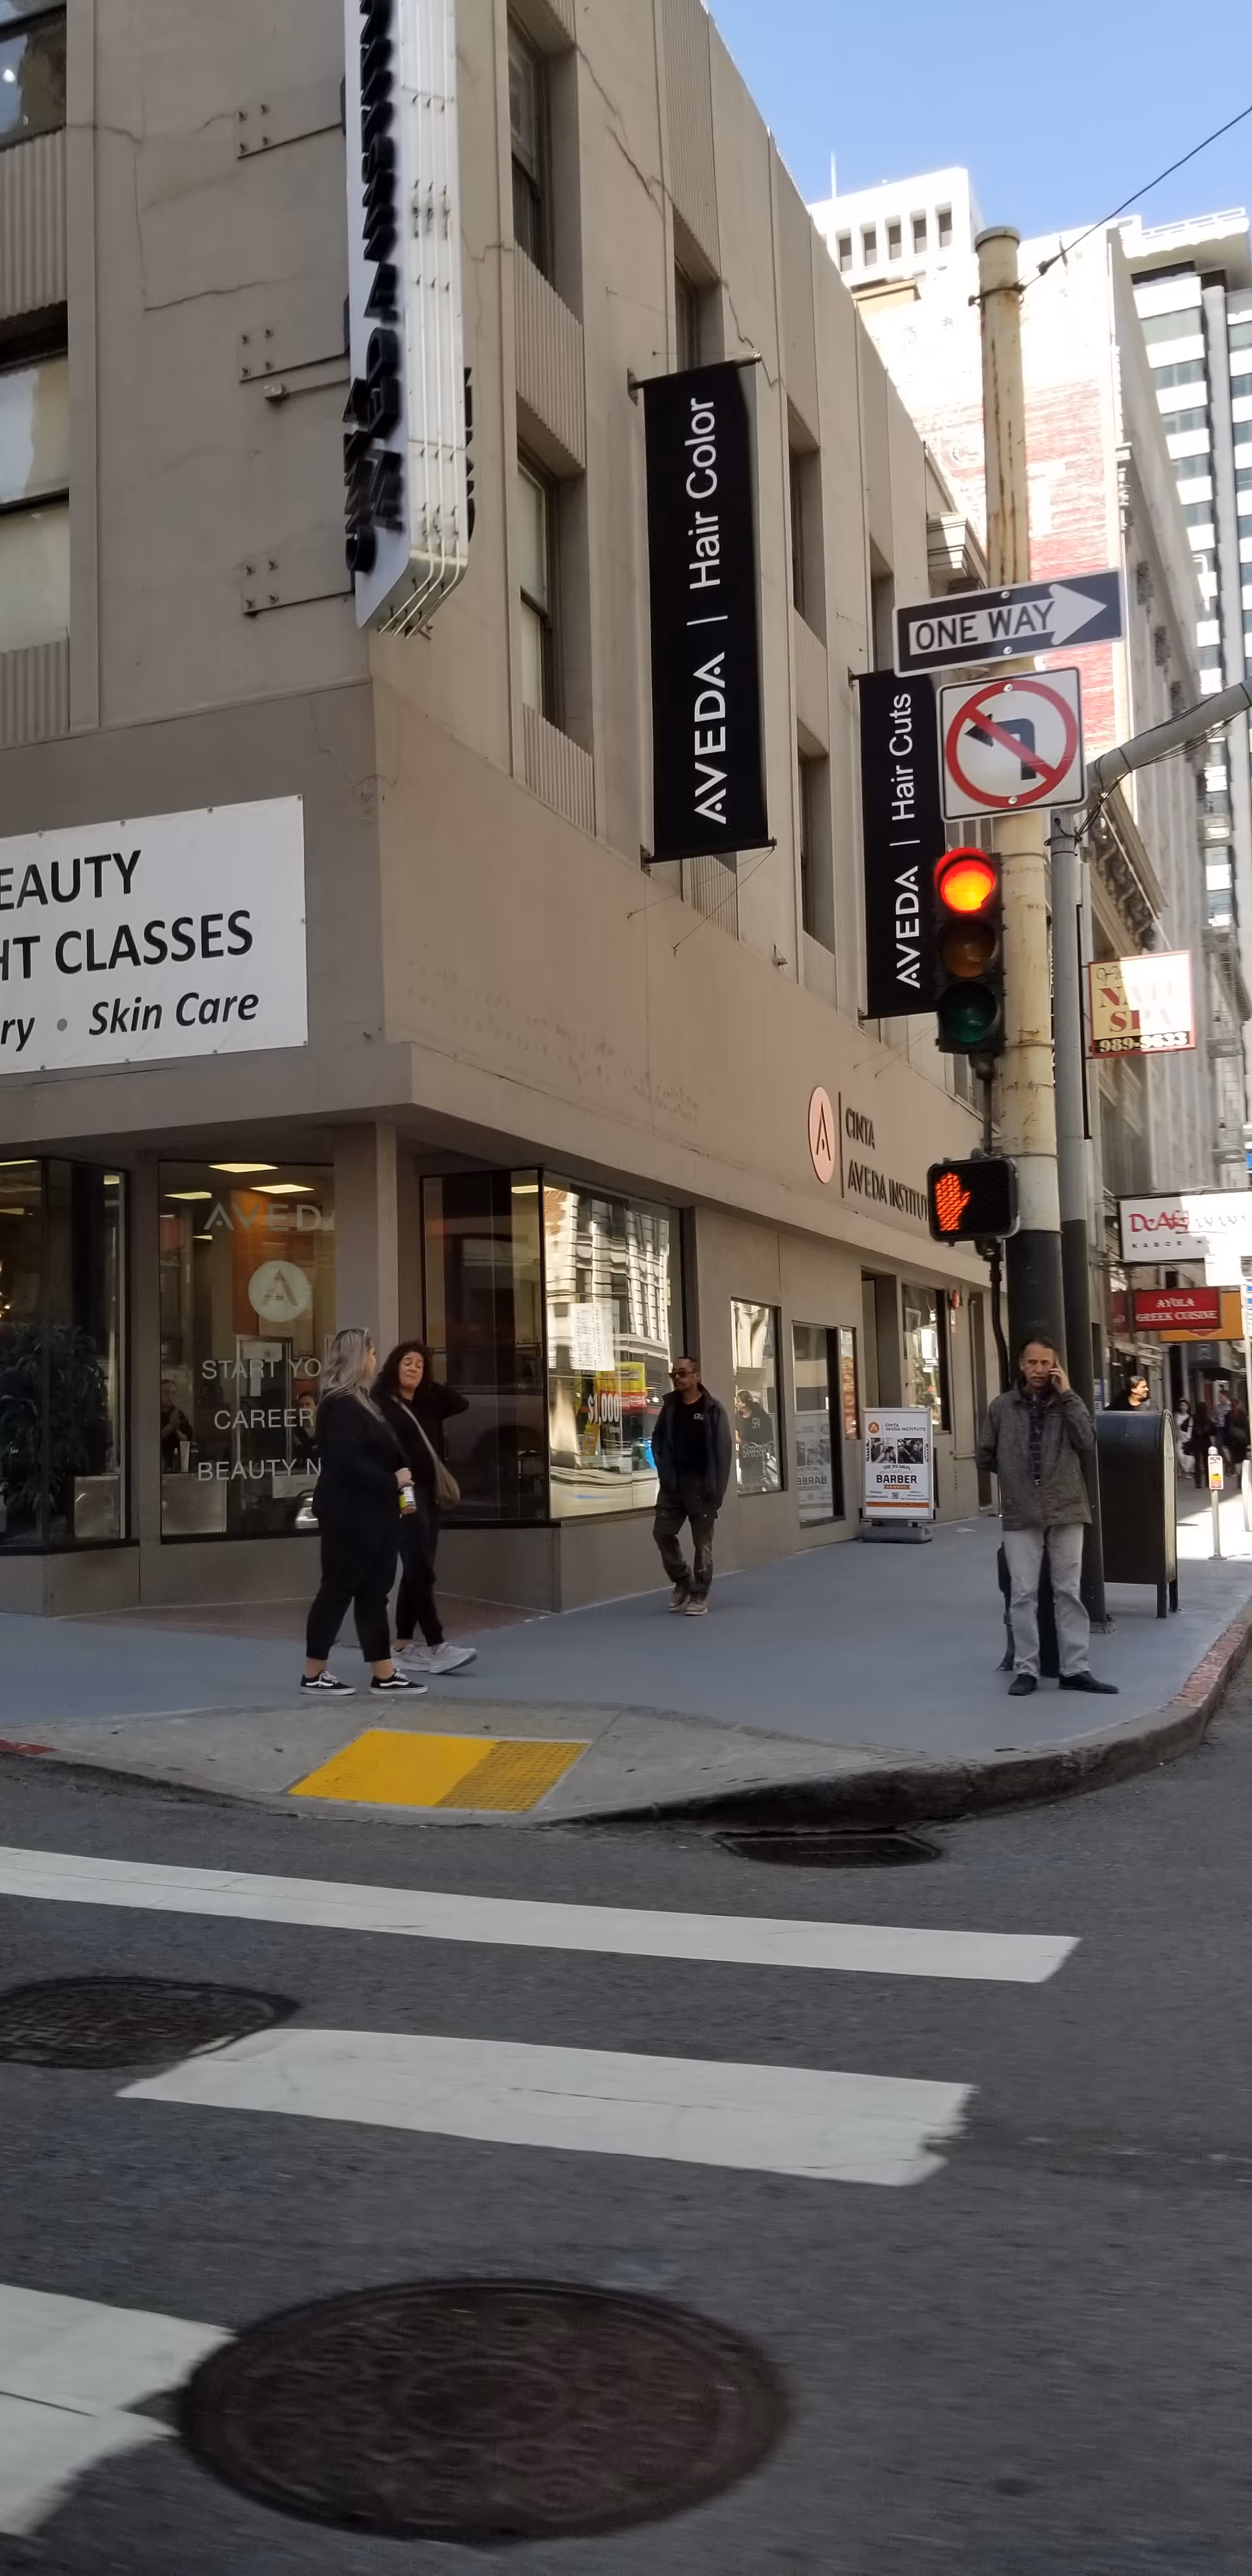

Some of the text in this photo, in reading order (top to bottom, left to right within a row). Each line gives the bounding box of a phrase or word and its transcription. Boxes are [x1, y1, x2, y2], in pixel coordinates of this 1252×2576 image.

[685, 397, 728, 825] AVEDA Hair Color
[916, 602, 1055, 650] ONE WAY
[889, 693, 920, 989] AVEDA Hair Cuts
[55, 910, 253, 974] CLASSES
[89, 996, 162, 1036] Skin
[175, 992, 260, 1027] Care
[846, 1107, 875, 1150] CINTA
[848, 1159, 887, 1205] AVEDA
[203, 1202, 335, 1231] AVED
[1135, 1312, 1174, 1321] GREEK
[1174, 1310, 1218, 1321] CUISINE
[1156, 1298, 1195, 1308] AYOLA
[201, 1358, 279, 1379] START
[214, 1408, 314, 1430] CAREER
[588, 1392, 619, 1426] $1,000
[198, 1459, 297, 1481] BEAUTY
[876, 1475, 917, 1484] BARBER
